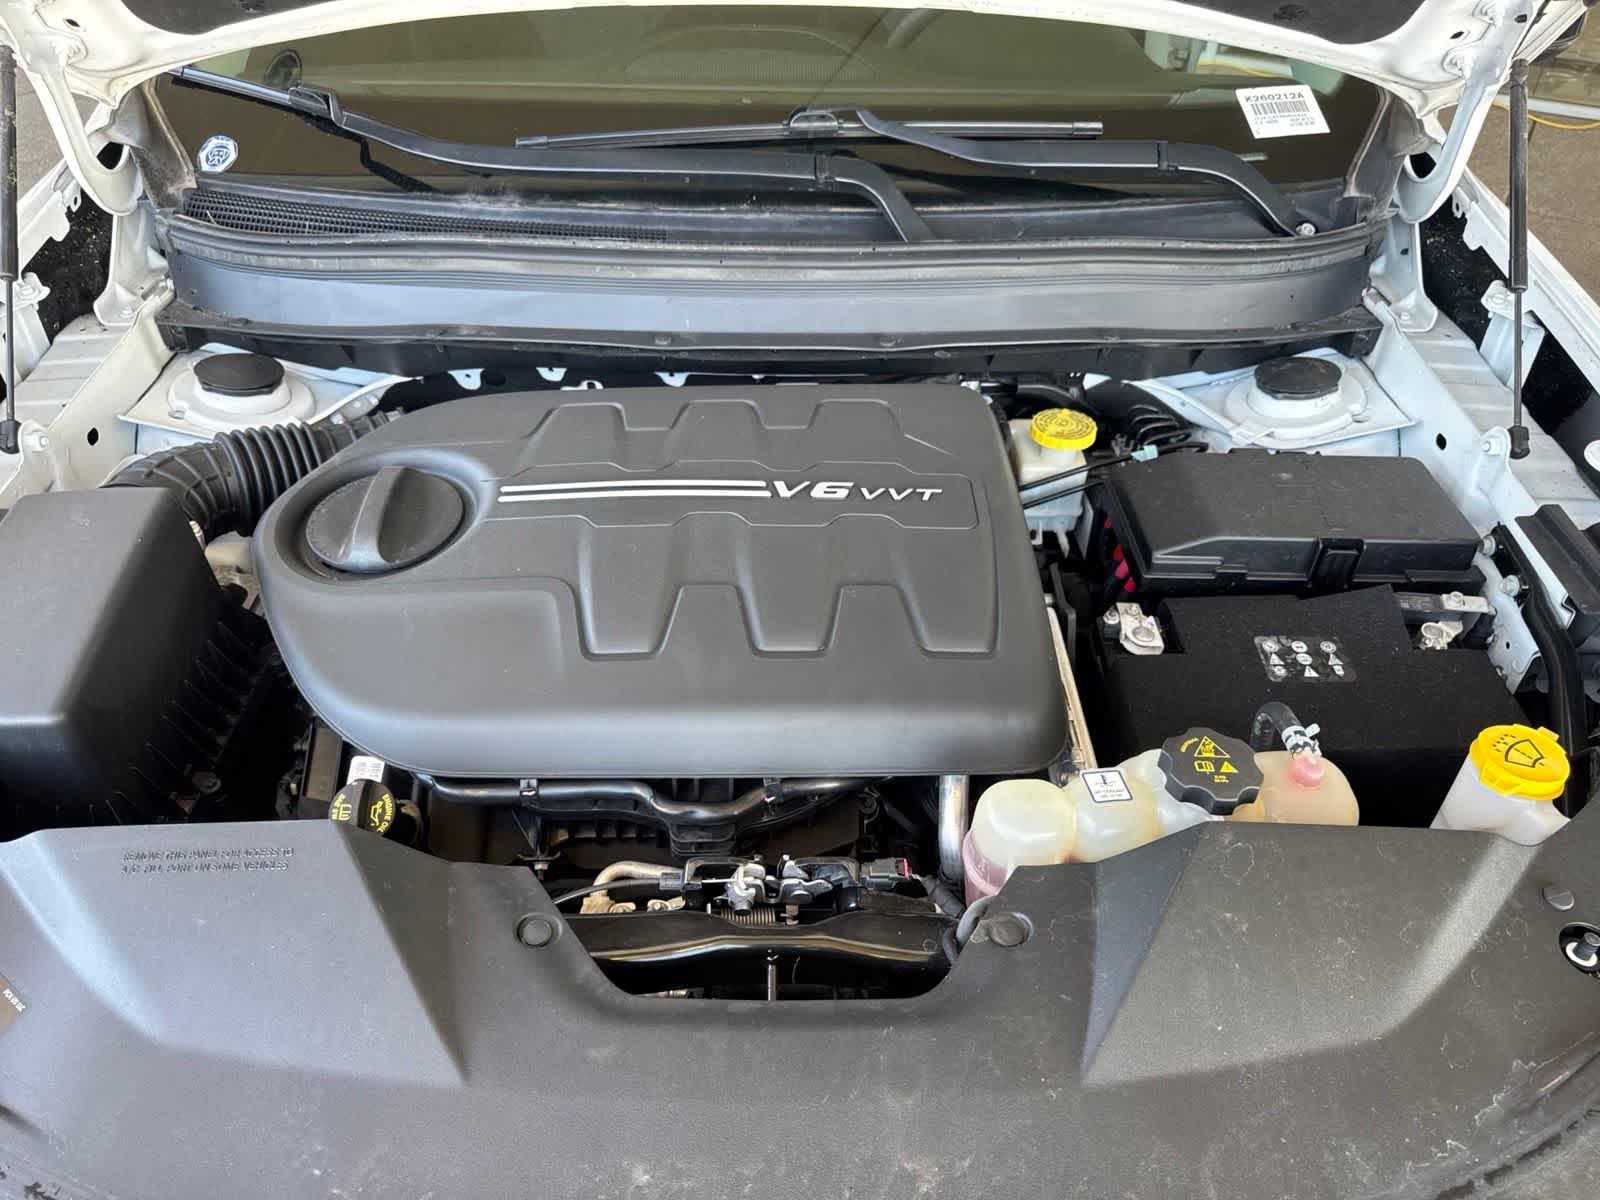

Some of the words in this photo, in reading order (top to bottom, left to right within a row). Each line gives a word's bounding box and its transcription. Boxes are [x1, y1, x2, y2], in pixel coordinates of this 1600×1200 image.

[1244, 92, 1305, 103] K260212A
[773, 480, 855, 499] V6
[860, 487, 943, 501] VVT
[382, 793, 393, 820] ENGINE
[120, 850, 162, 861] REMOVE
[164, 849, 187, 860] THIS
[188, 848, 218, 859] PANEL
[242, 847, 280, 858] ACCESS
[242, 860, 289, 873] VEHICLES
